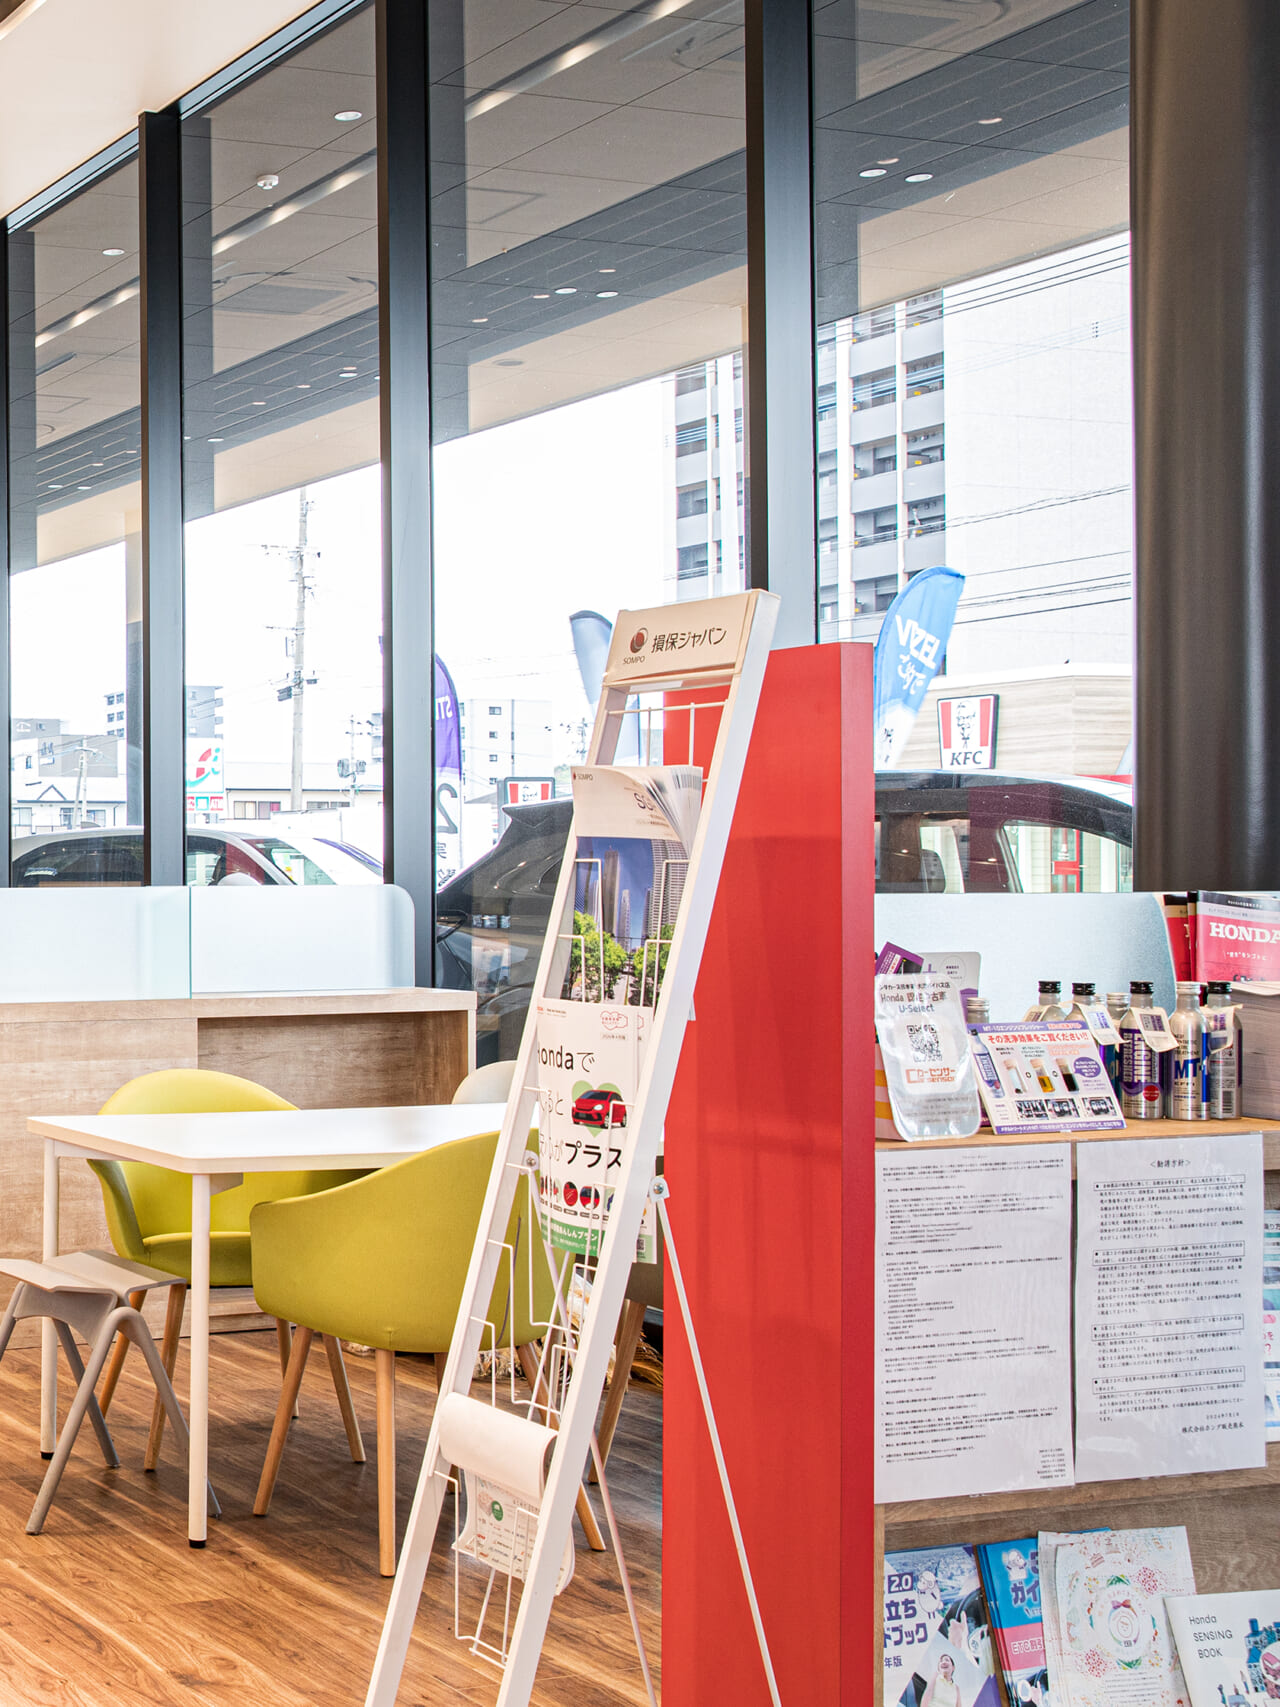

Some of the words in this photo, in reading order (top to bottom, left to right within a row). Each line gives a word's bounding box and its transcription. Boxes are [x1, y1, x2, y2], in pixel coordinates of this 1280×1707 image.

[651, 627, 727, 654] 損保ジャパン
[623, 655, 646, 665] SOMPO
[949, 750, 983, 766] KFC
[899, 1003, 936, 1014] U-Select
[1134, 1033, 1152, 1083] ENGINE
[889, 1573, 912, 1593] 2.0
[884, 1598, 918, 1621] 立ち
[1189, 1614, 1217, 1625] Honda
[1193, 1629, 1233, 1642] SENSING
[1197, 1648, 1223, 1659] BOOK
